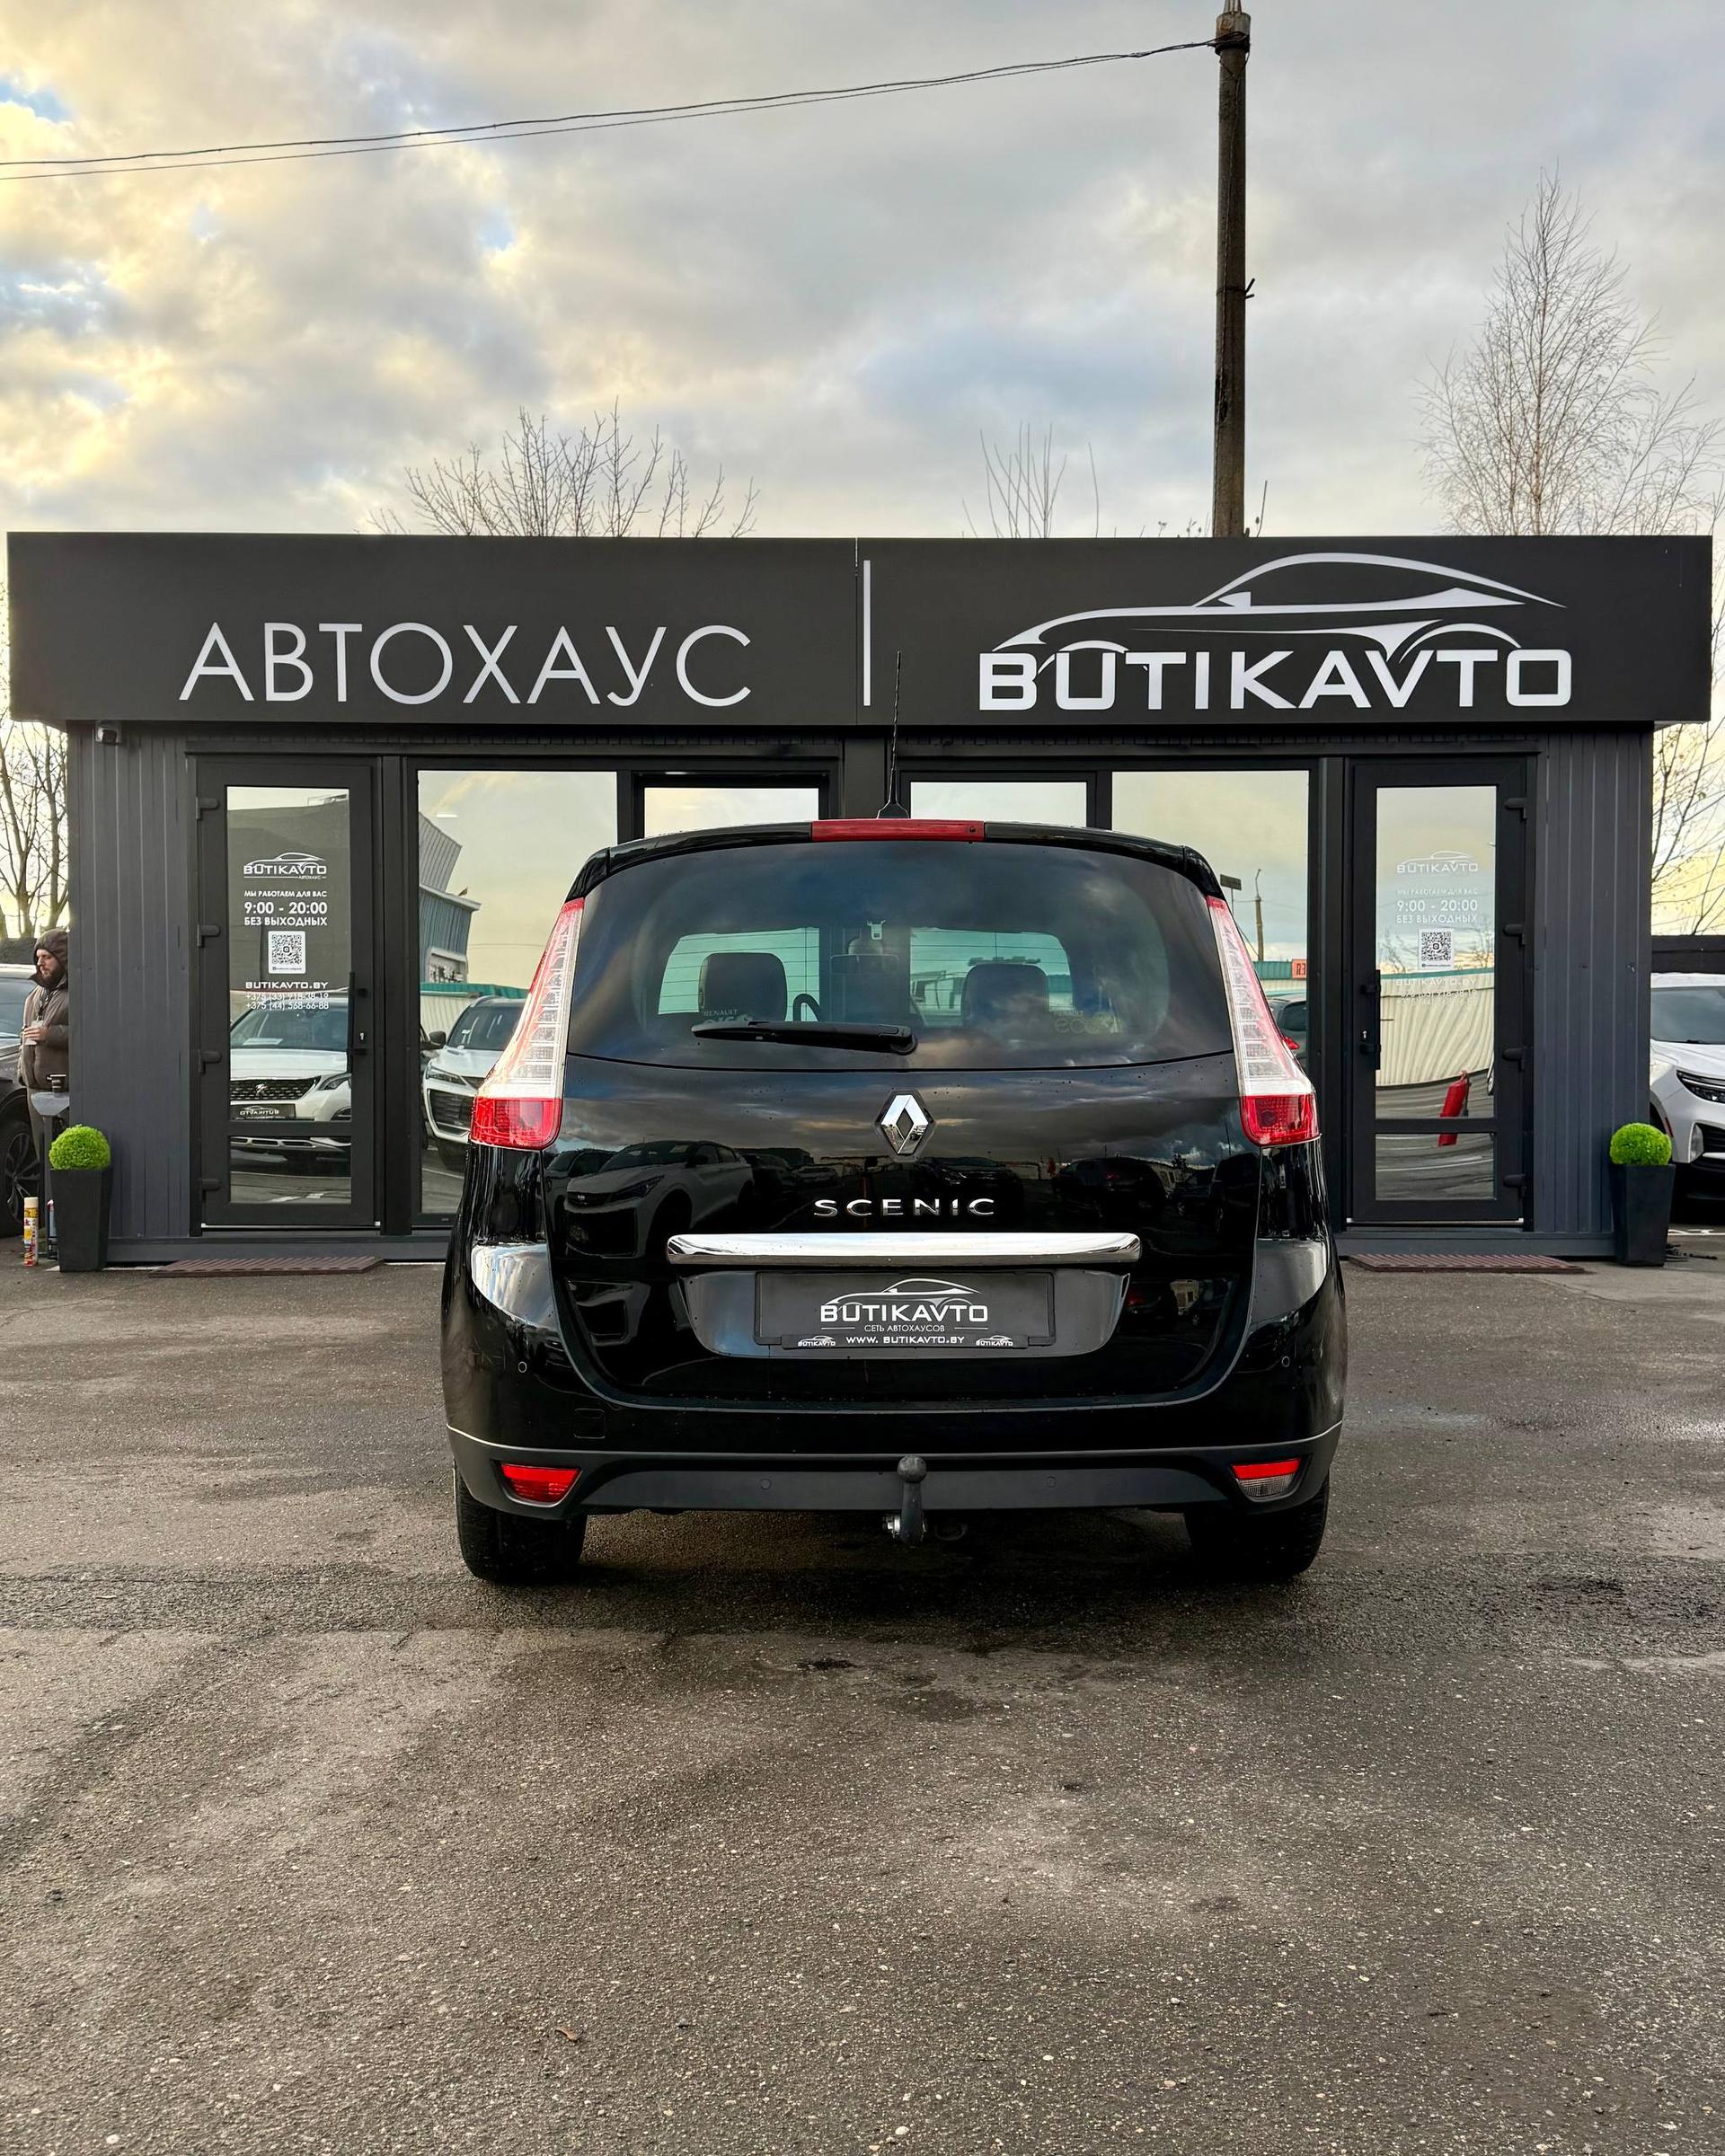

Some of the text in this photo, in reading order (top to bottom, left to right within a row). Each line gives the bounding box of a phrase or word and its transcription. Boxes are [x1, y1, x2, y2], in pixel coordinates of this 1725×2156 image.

[179, 622, 752, 708] АВТОХАУС
[978, 649, 1572, 711] BUTIKAVTO
[243, 865, 328, 875] BUTIKAVTO
[1396, 862, 1479, 874] BUTIKAVTO
[296, 890, 311, 898] ДЛЯ
[243, 901, 275, 915] 9:00
[288, 901, 328, 915] 20:00
[1396, 899, 1426, 912] 9:00
[1440, 899, 1478, 912] 20:00
[243, 916, 328, 927] БЕЗ ВЫХОДНЫХ
[1396, 914, 1478, 924] БЕЗ ВЫХОДНЫХ
[245, 981, 329, 990] BUTIKAVTO.BY
[245, 1002, 267, 1010] +375
[269, 1002, 285, 1011] (44)
[813, 1197, 995, 1217] SCENIC
[820, 1304, 988, 1322] BUTIKAVTO
[863, 1324, 945, 1333] СЕТЬ АВТОХАУСОВ
[845, 1336, 965, 1345] WWW. BUTIKAVTO.BY
